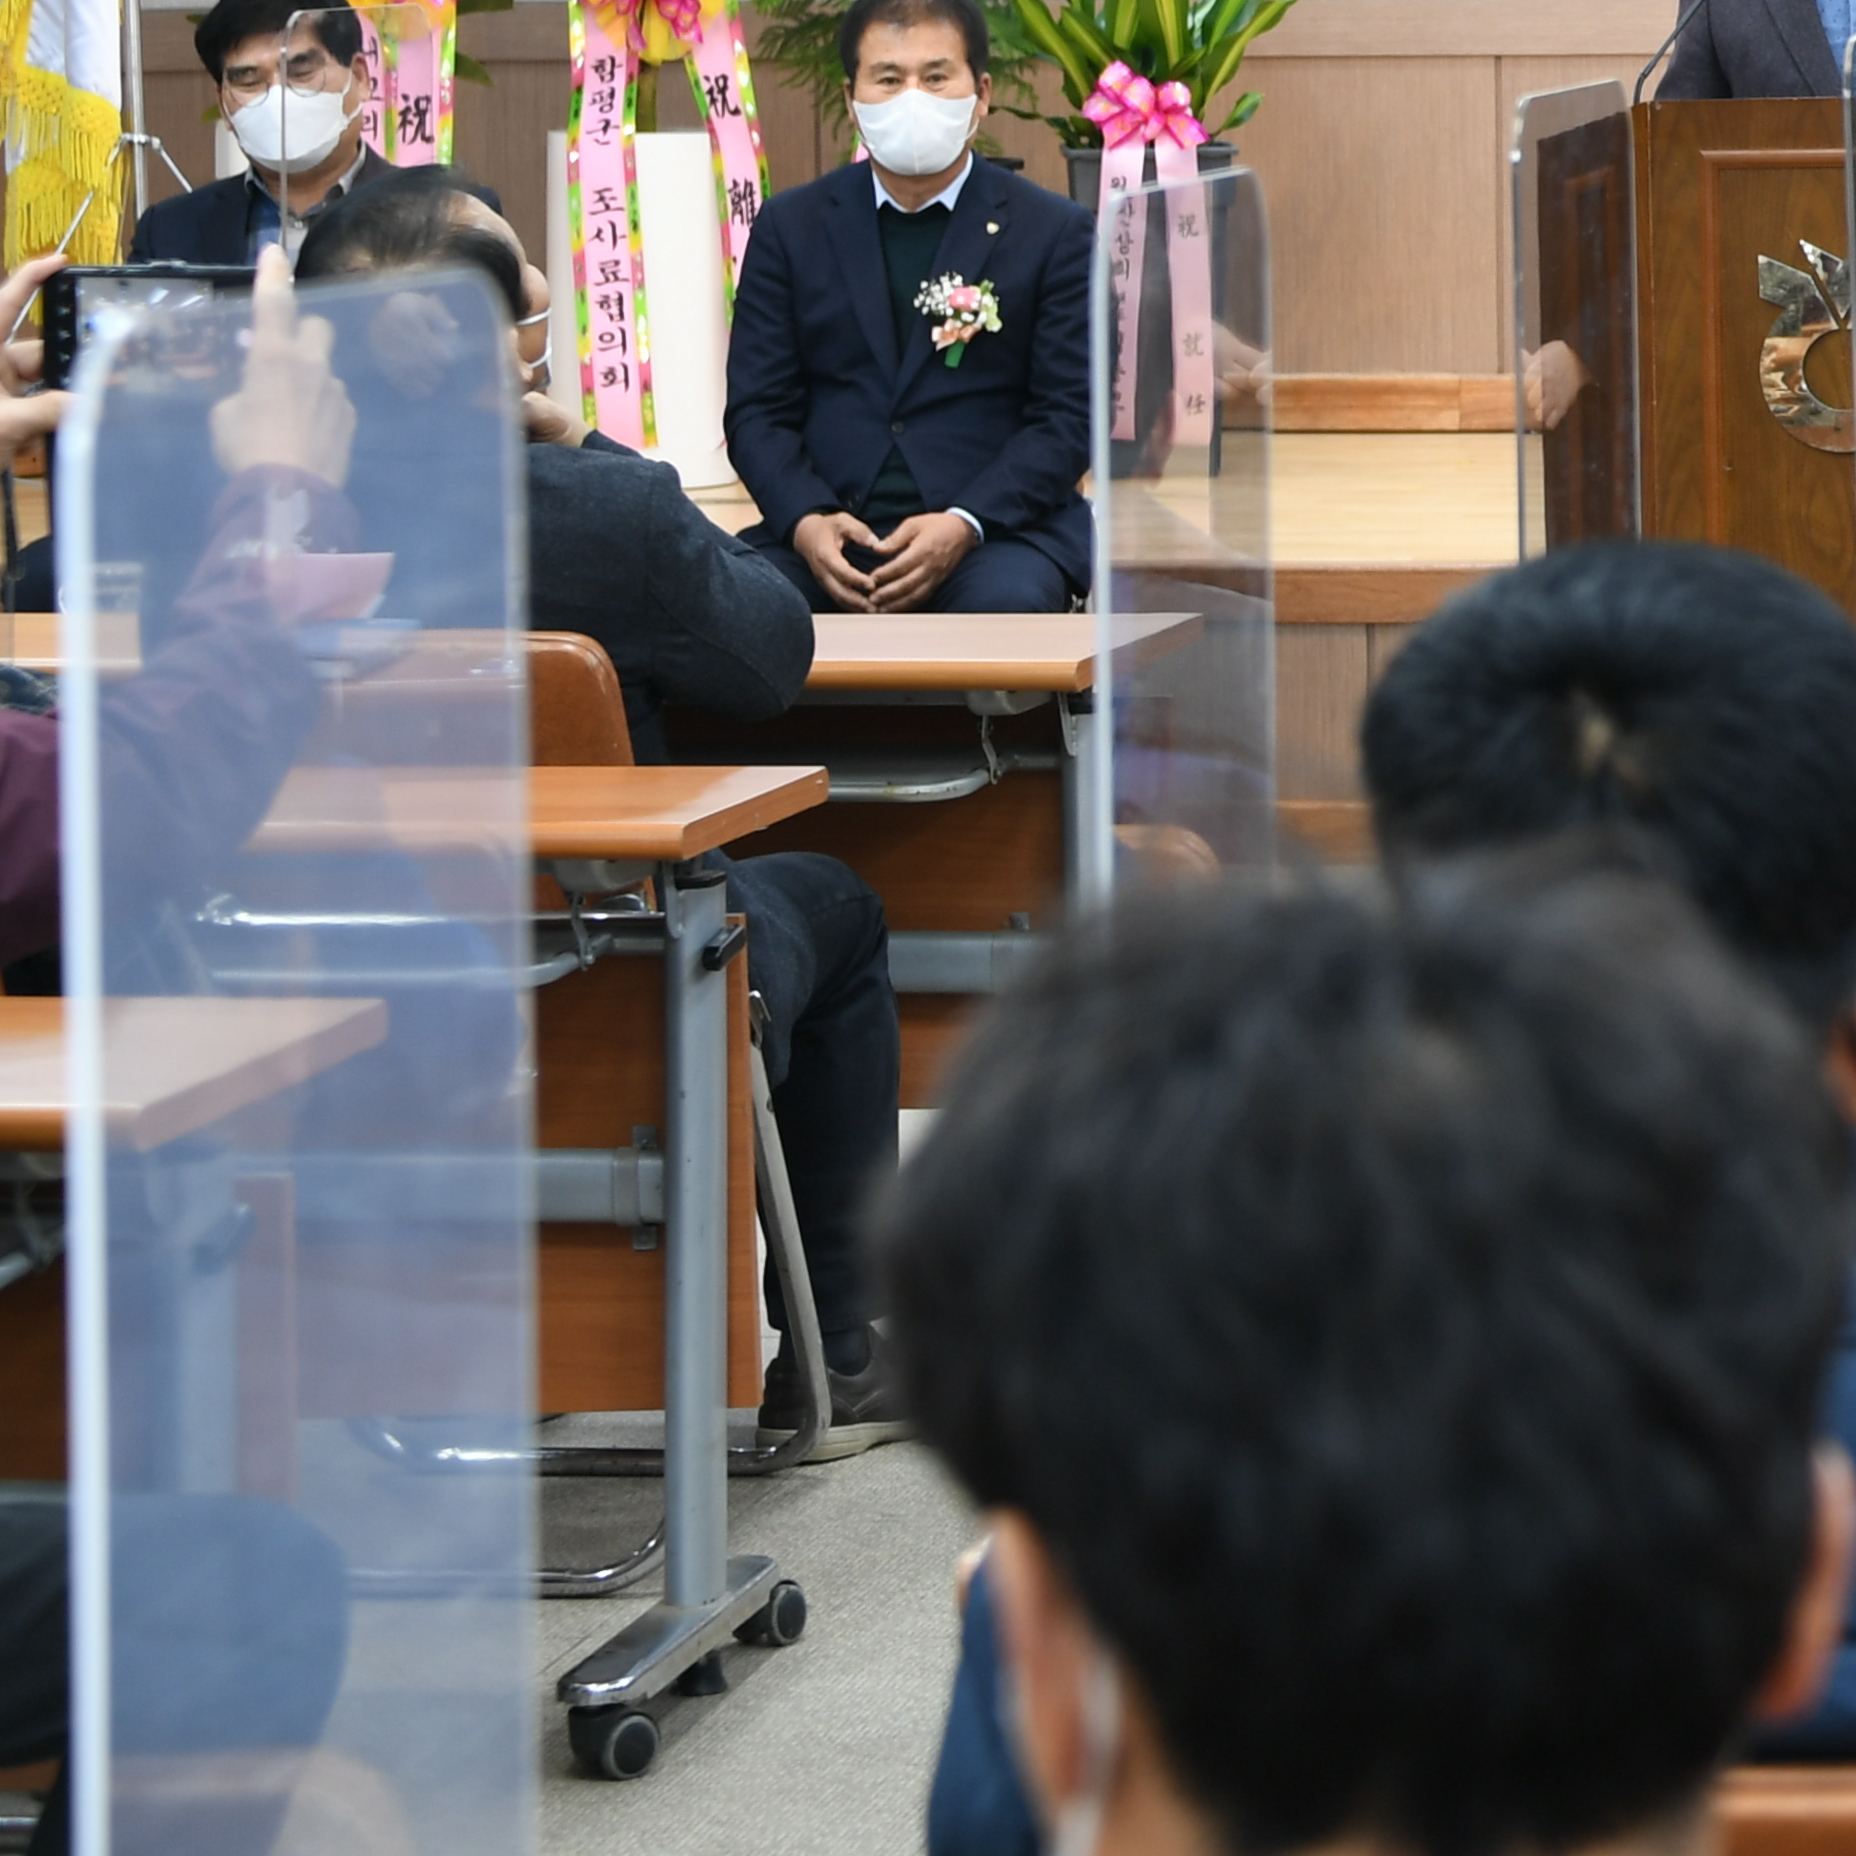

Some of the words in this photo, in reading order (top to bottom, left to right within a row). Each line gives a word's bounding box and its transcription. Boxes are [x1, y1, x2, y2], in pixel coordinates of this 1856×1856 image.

[398, 92, 435, 145] 祝
[585, 54, 623, 146] 함평군
[700, 72, 742, 119] 祝
[587, 186, 631, 394] 조사료협의회
